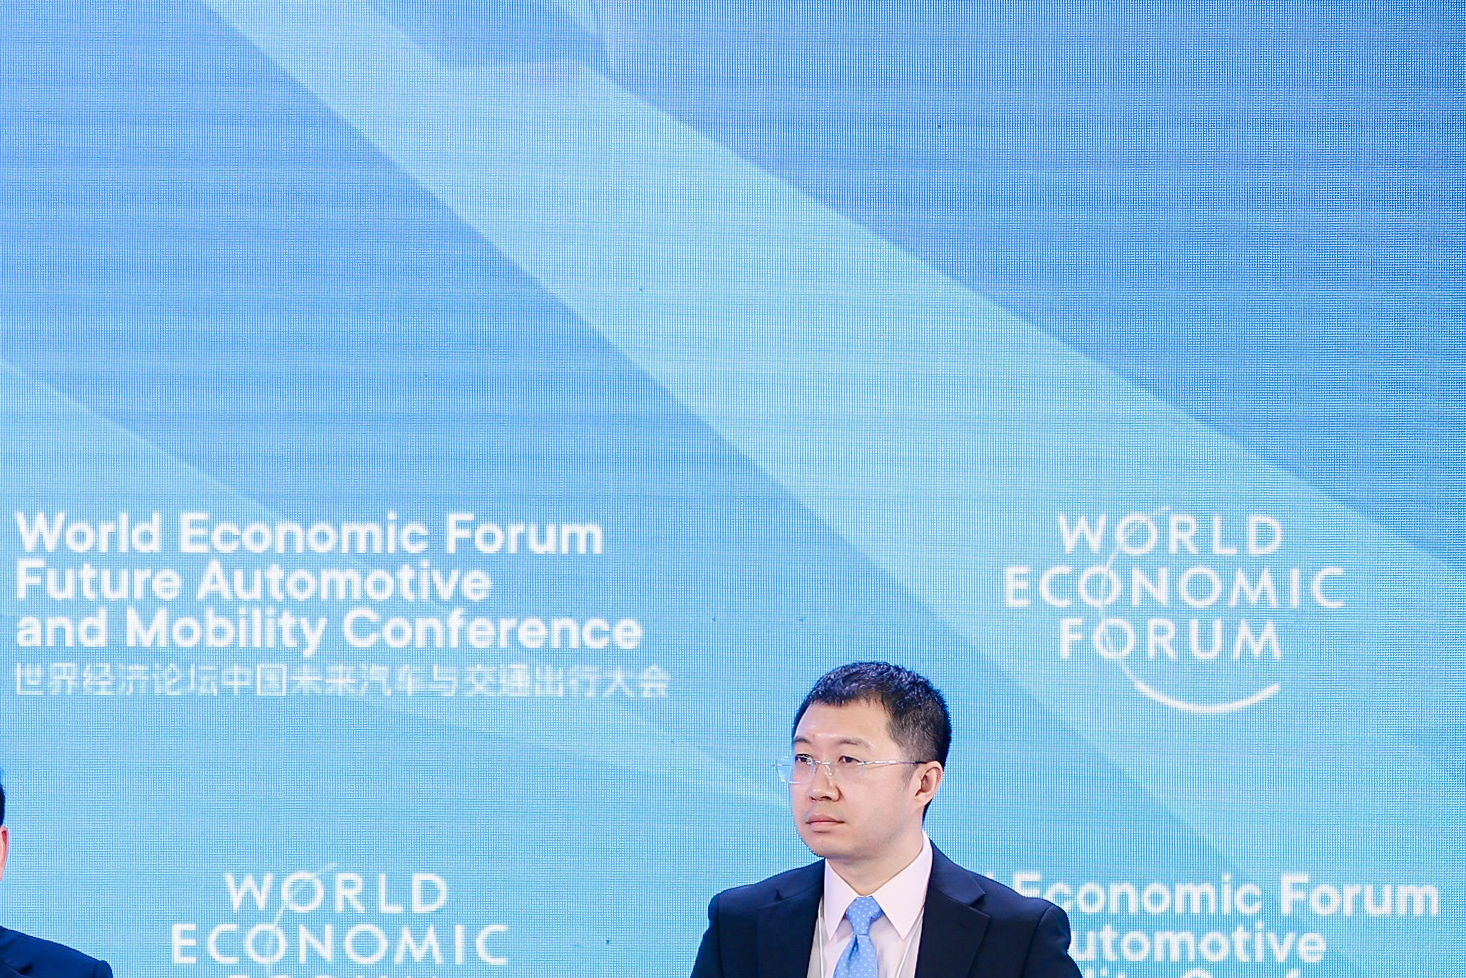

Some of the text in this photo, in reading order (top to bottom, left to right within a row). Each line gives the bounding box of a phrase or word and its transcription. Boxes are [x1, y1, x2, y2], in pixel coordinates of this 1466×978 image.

[15, 511, 603, 554] World Economic Forum
[1057, 512, 1282, 555] WORLD
[16, 558, 492, 602] Future Automotive
[1004, 561, 1344, 611] ECONOMIC
[16, 606, 643, 658] and Mobility Conference
[1060, 617, 1282, 660] FORUM
[225, 871, 448, 915] WORLD
[1280, 873, 1439, 916] Forum
[171, 922, 507, 966] ECONOMIC
[1071, 922, 1327, 963] utomotive
